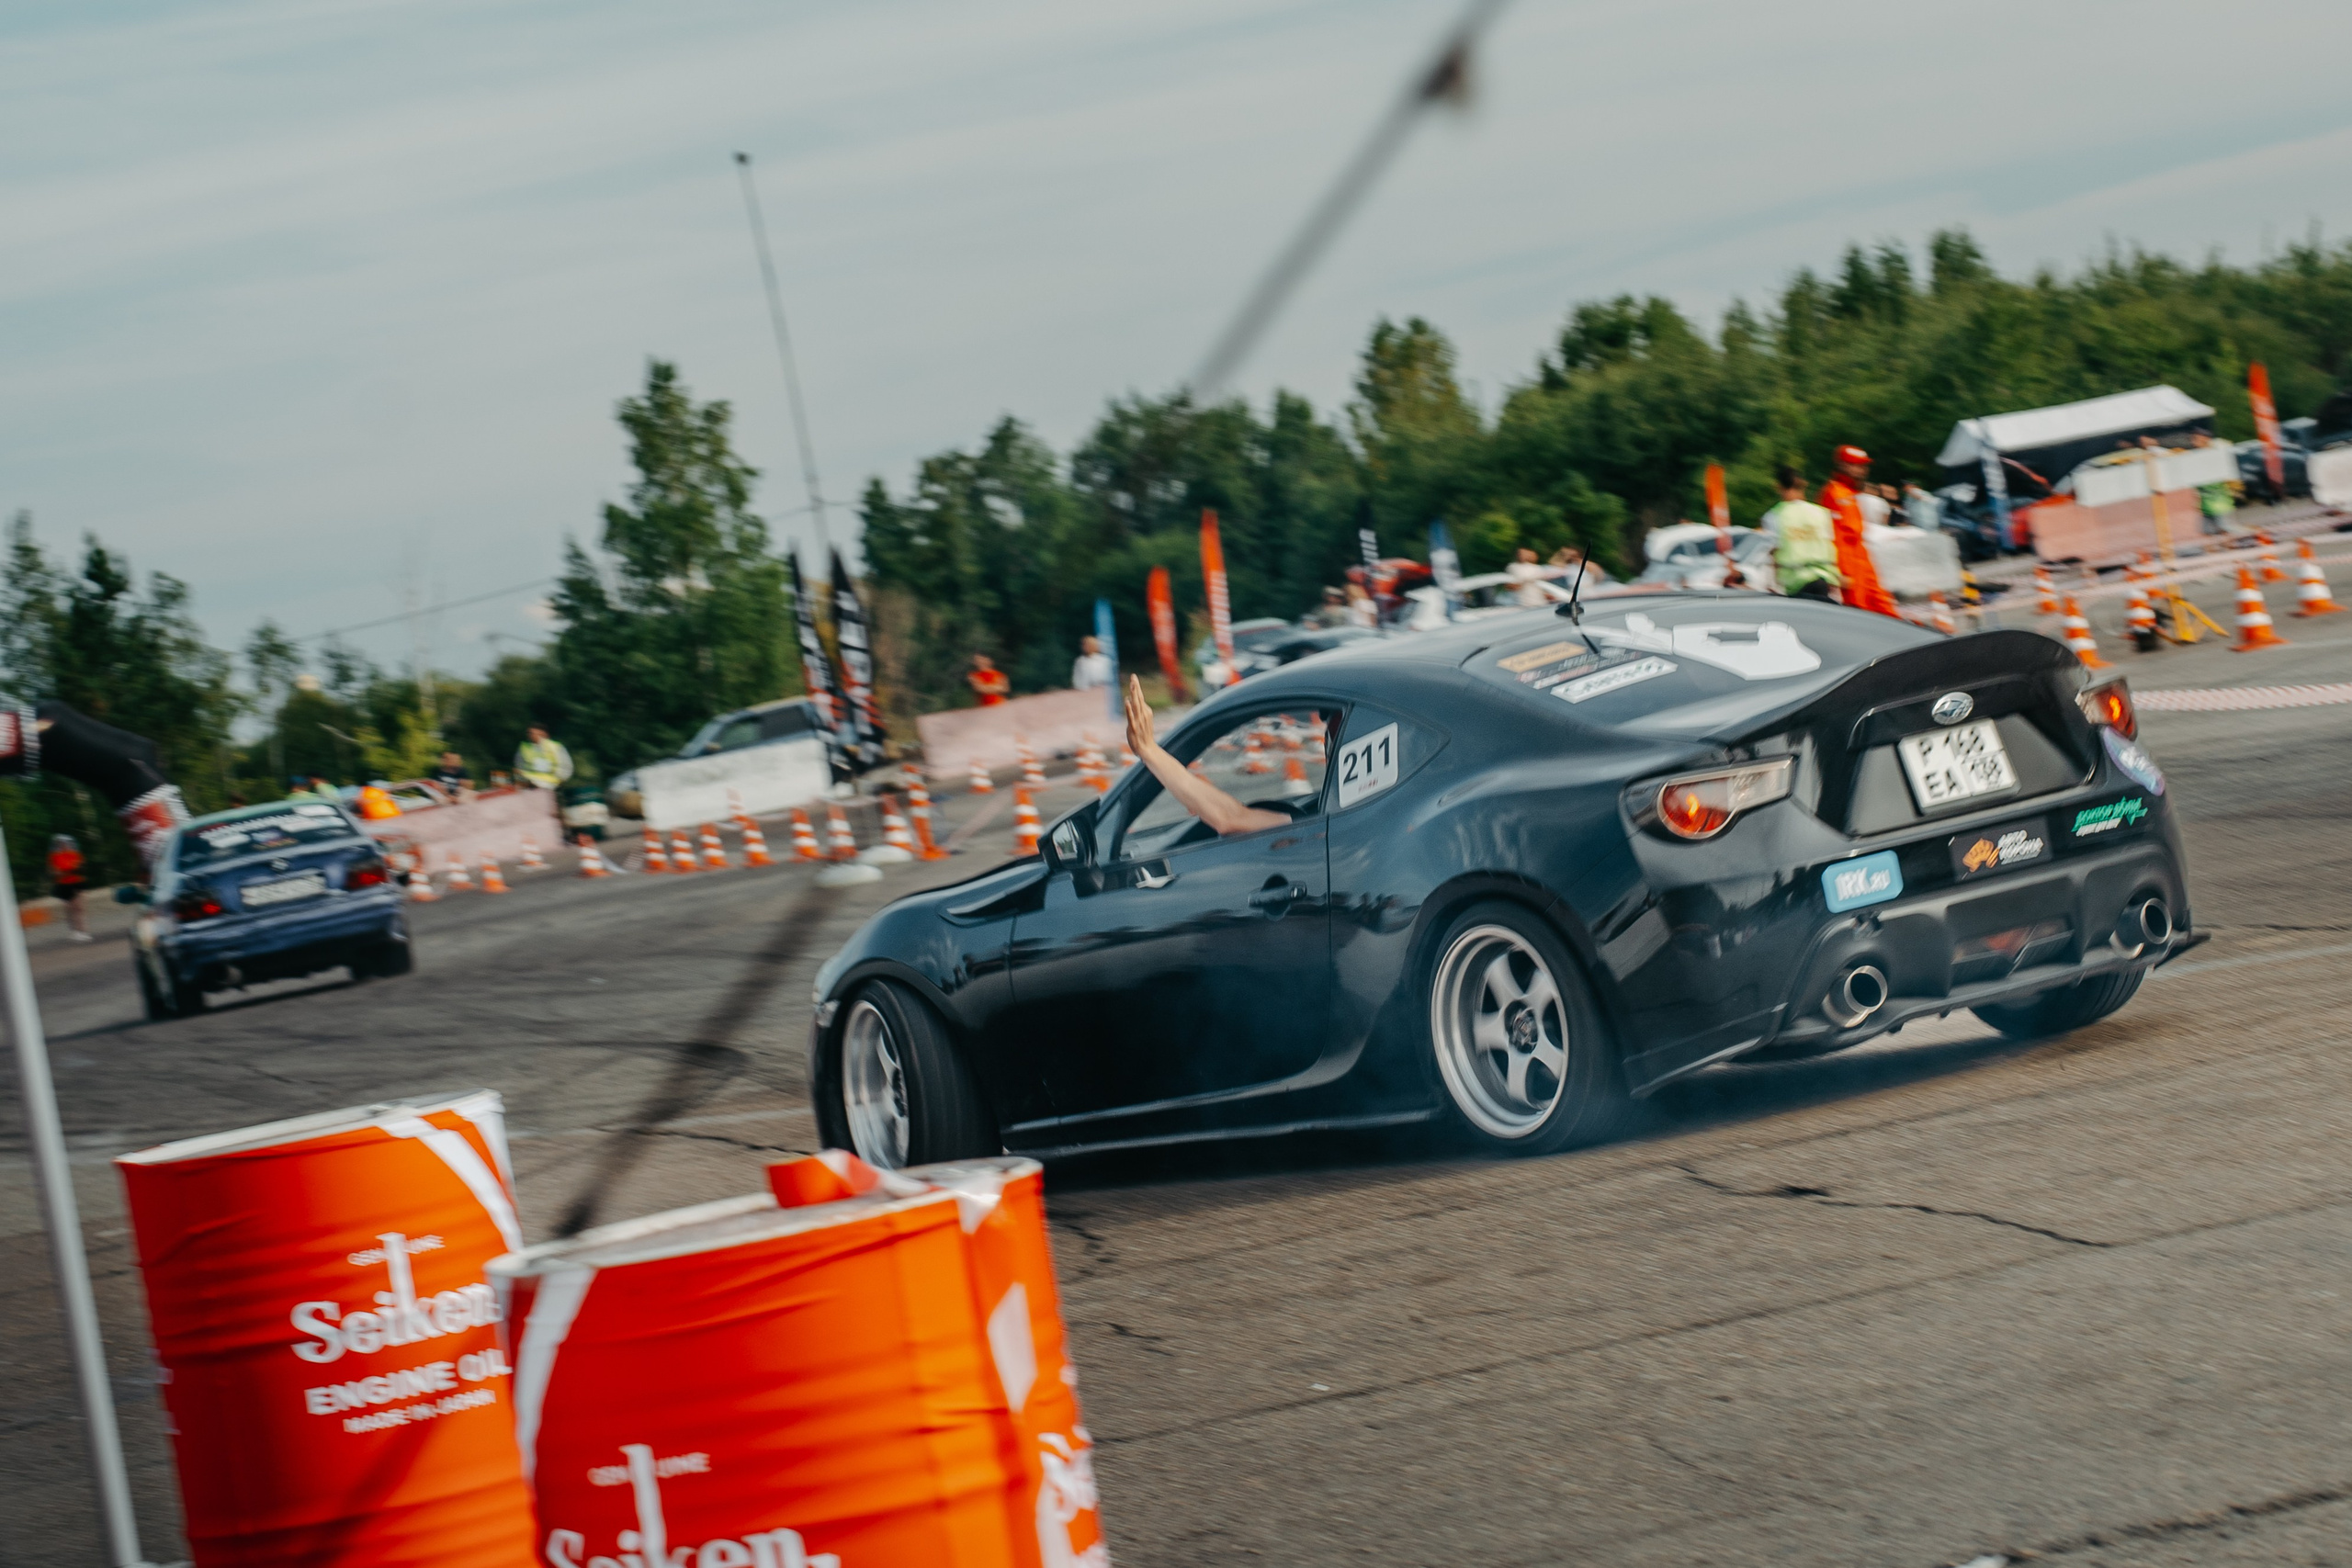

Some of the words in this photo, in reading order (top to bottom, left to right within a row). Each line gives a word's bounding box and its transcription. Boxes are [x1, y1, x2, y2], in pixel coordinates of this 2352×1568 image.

[1342, 733, 1391, 786] 211
[289, 1232, 504, 1364] Seiken
[304, 1360, 459, 1416] ENGINE
[458, 1348, 514, 1382] OIL
